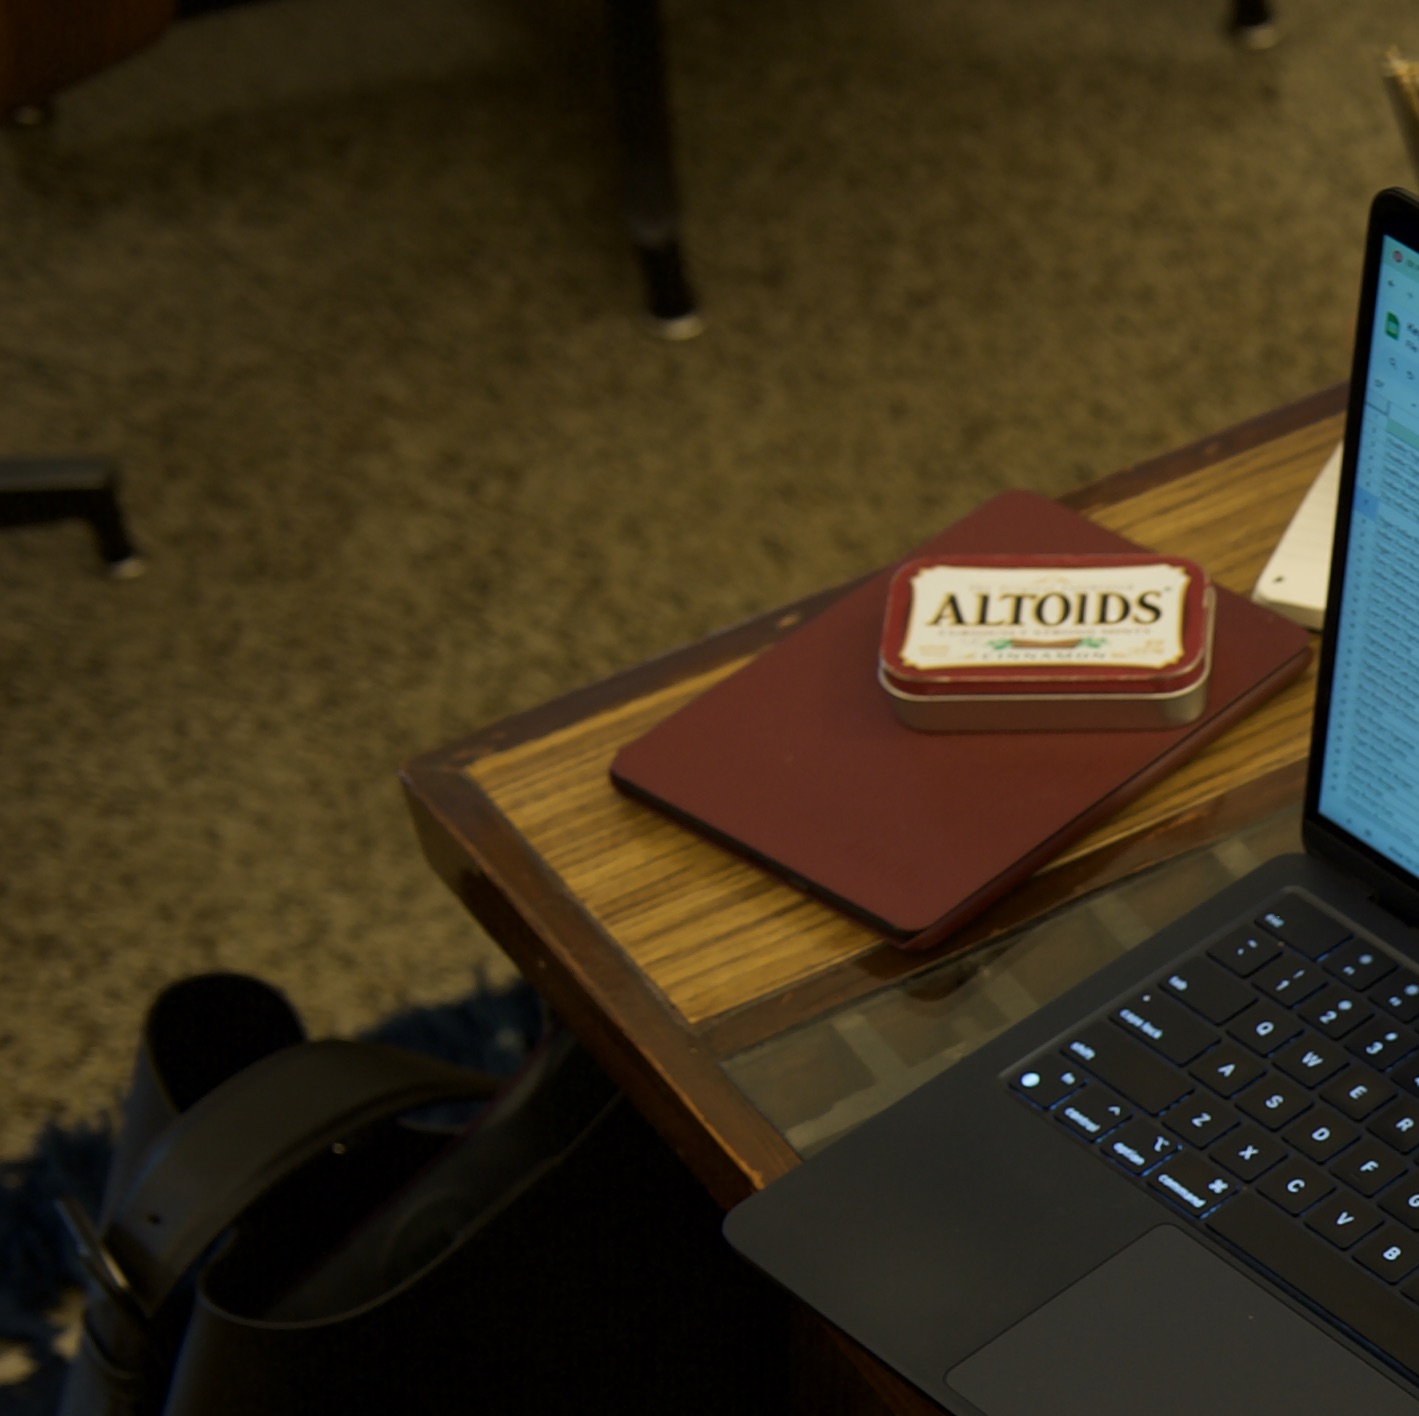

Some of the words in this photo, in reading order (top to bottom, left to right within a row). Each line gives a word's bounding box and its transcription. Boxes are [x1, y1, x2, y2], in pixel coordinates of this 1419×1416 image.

[925, 591, 1163, 627] ALTOIDS
[1319, 1010, 1337, 1023] 2
[1256, 1021, 1274, 1036] Q
[1366, 1041, 1383, 1054] 3
[1302, 1051, 1323, 1067] W
[1218, 1064, 1235, 1077] A
[1349, 1085, 1367, 1099] E
[1265, 1095, 1284, 1109] S
[1192, 1112, 1211, 1127] Z
[1396, 1117, 1414, 1132] R
[1311, 1127, 1330, 1141] D
[1238, 1145, 1258, 1160] X
[1360, 1160, 1378, 1172] F
[1158, 1174, 1206, 1208] command
[1287, 1179, 1305, 1193] C
[1336, 1211, 1354, 1225] V
[1383, 1246, 1401, 1261] B
